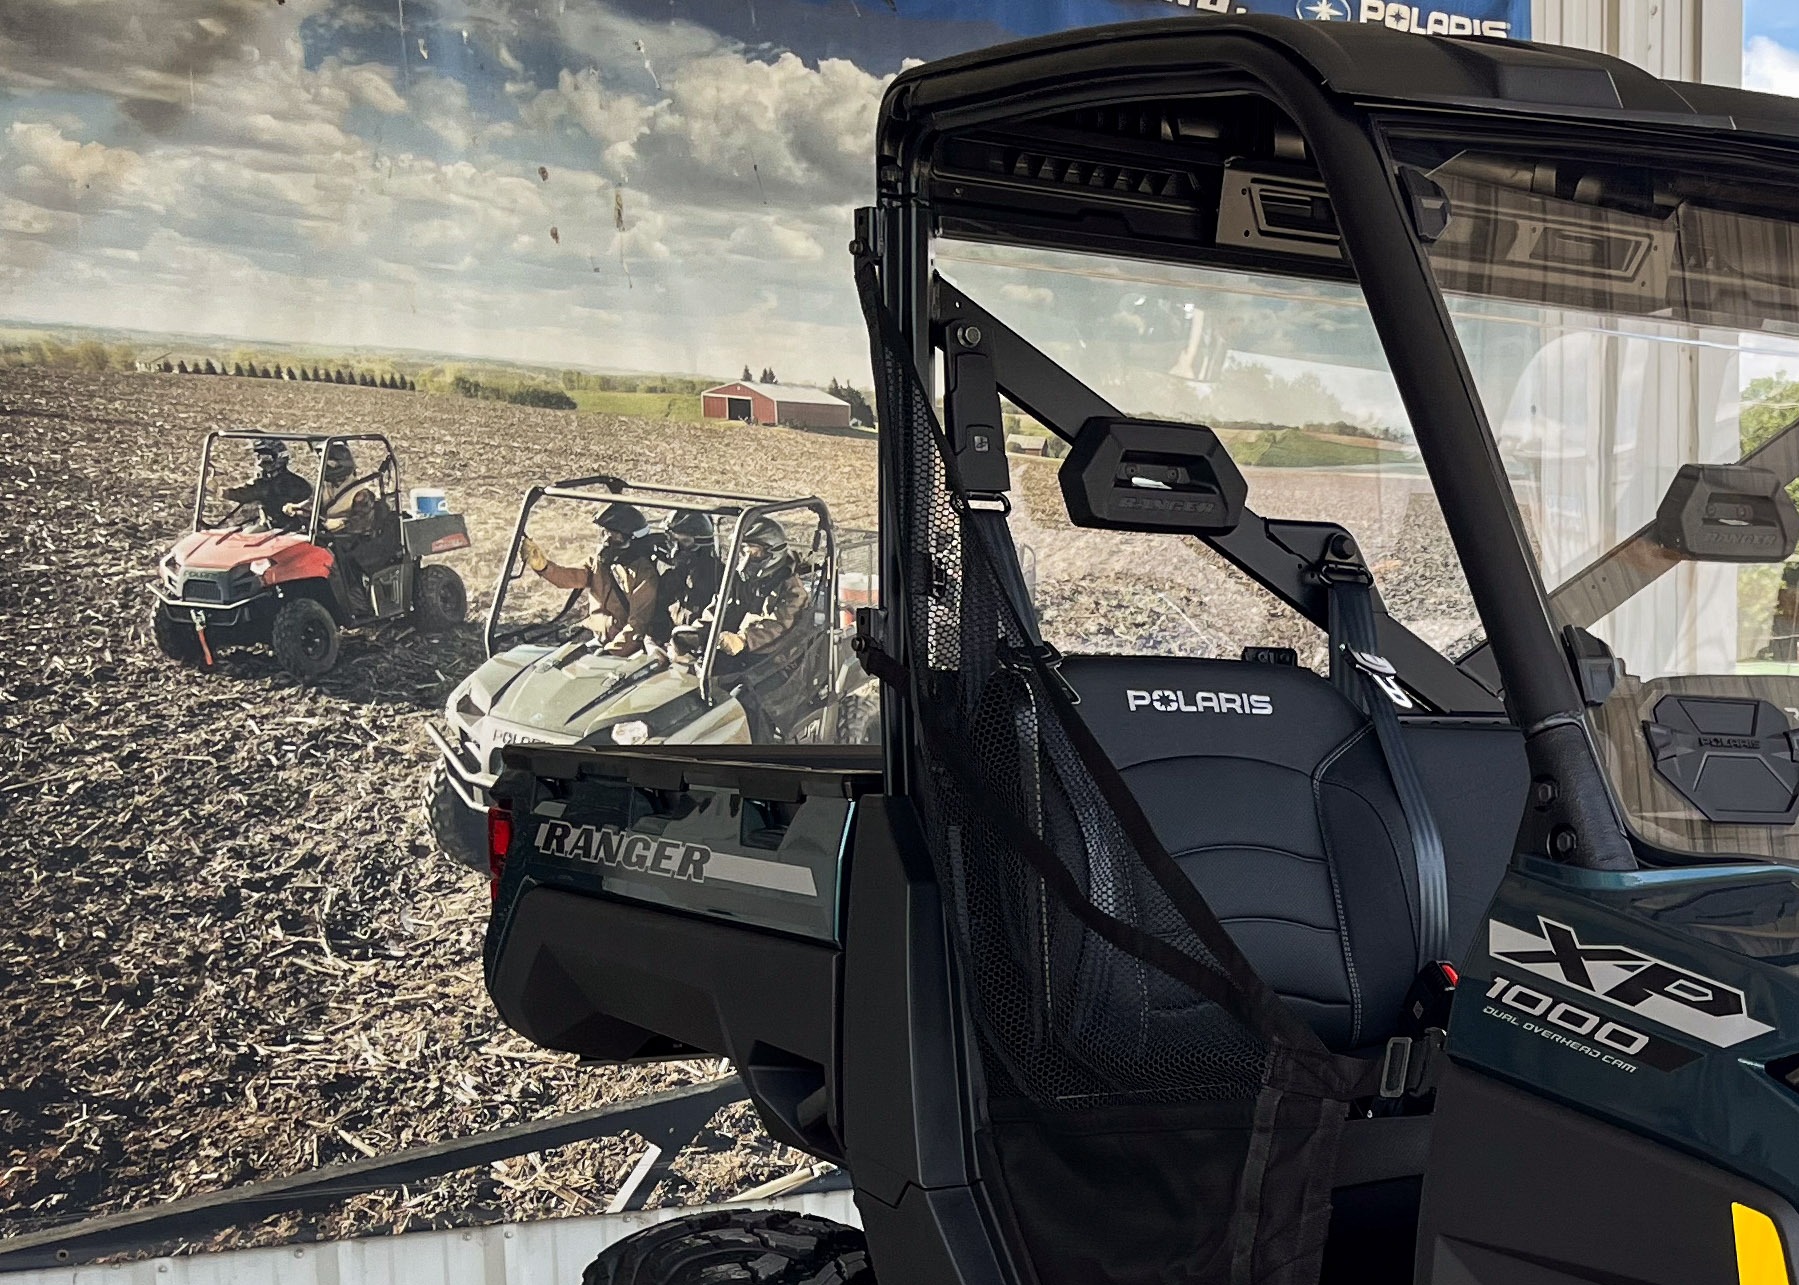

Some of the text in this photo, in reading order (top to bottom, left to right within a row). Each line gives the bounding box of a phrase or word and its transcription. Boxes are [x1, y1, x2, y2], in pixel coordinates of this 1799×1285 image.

[1359, 0, 1510, 39] POLARIS
[1126, 689, 1273, 715] POLARIS
[1698, 737, 1761, 750] POLARIS
[538, 819, 712, 884] RANGER
[1490, 915, 1750, 1018] XP
[1482, 1005, 1638, 1074] DUAL OVERHEAD CAM
[1486, 976, 1650, 1055] 1000
